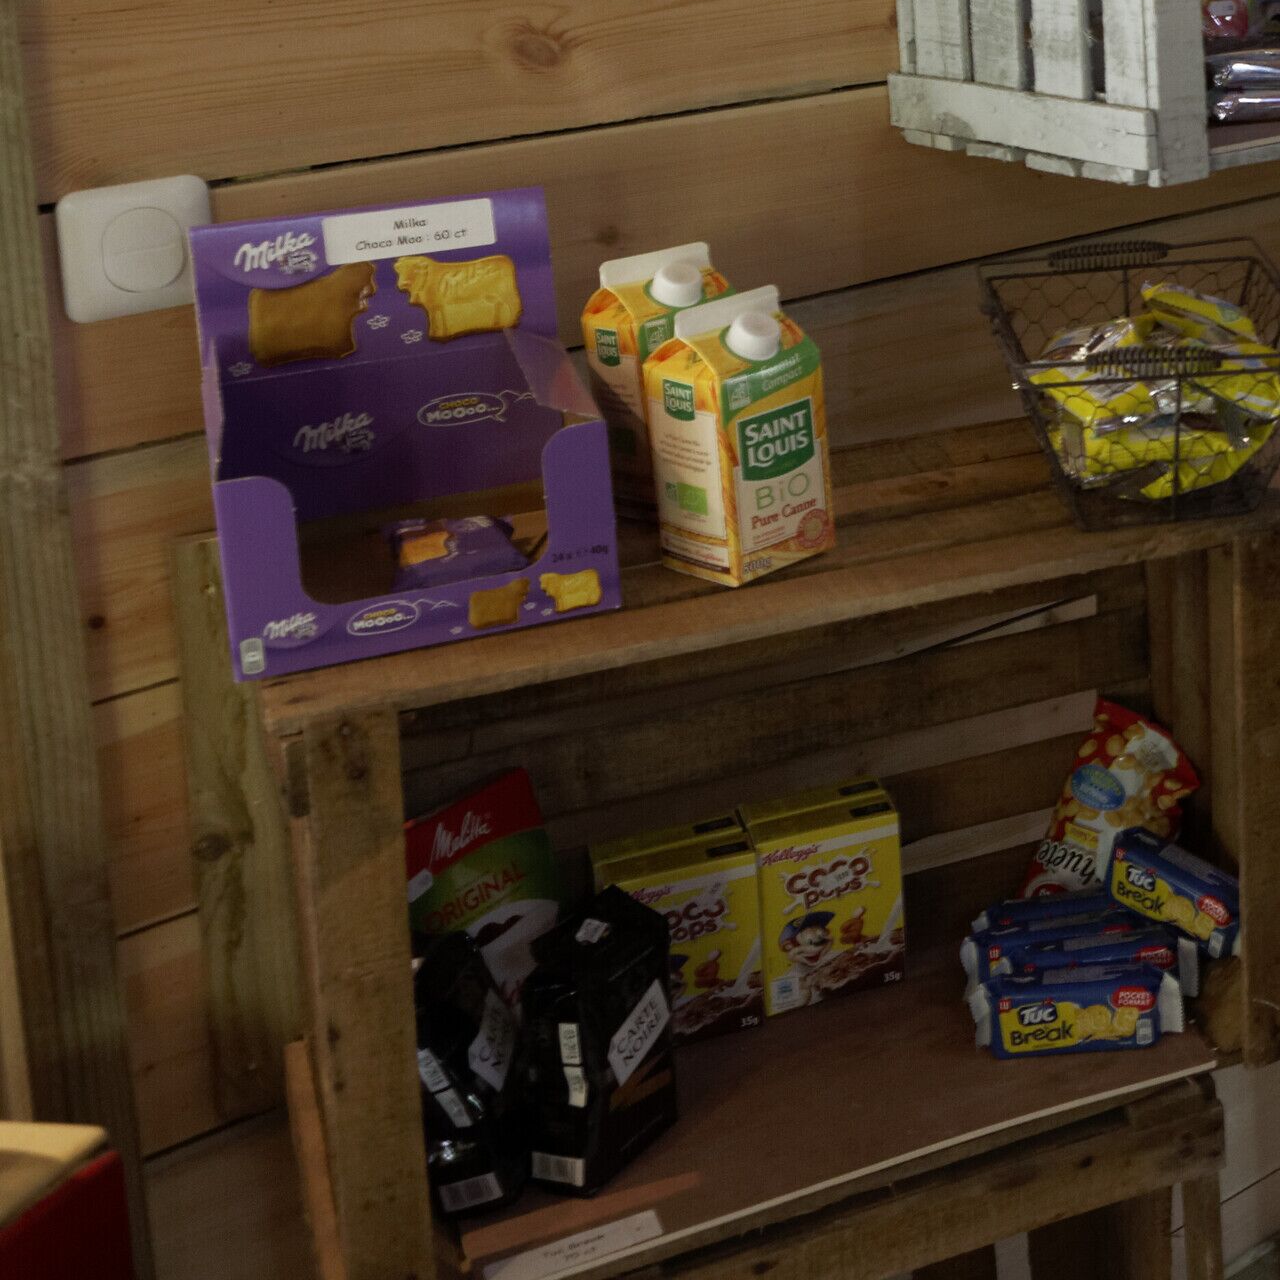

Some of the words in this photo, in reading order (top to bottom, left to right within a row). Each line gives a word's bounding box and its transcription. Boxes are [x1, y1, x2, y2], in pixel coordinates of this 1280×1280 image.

[393, 218, 427, 230] Milka
[233, 231, 319, 272] Milka
[355, 240, 393, 252] Choco
[397, 234, 423, 246] Moo
[596, 328, 619, 348] SAINT
[663, 382, 693, 401] SAINT
[665, 396, 694, 414] LOUIS
[292, 410, 375, 454] Milka
[744, 407, 810, 446] SAINT
[747, 429, 810, 469] LOUIS
[750, 505, 779, 531] Pure
[781, 497, 818, 519] Canne
[429, 809, 494, 870] Melitta
[761, 843, 822, 867] Kellogg's
[1124, 866, 1155, 891] TUC
[420, 859, 527, 929] ORIGINAL
[1115, 880, 1166, 915] Break
[662, 898, 726, 932] OCO
[672, 918, 718, 942] ops
[884, 969, 902, 983] 35g
[1117, 990, 1152, 1001] POCKET
[1118, 998, 1151, 1009] FORMAT
[1018, 1006, 1057, 1026] TUC
[1010, 1021, 1074, 1047] Break
